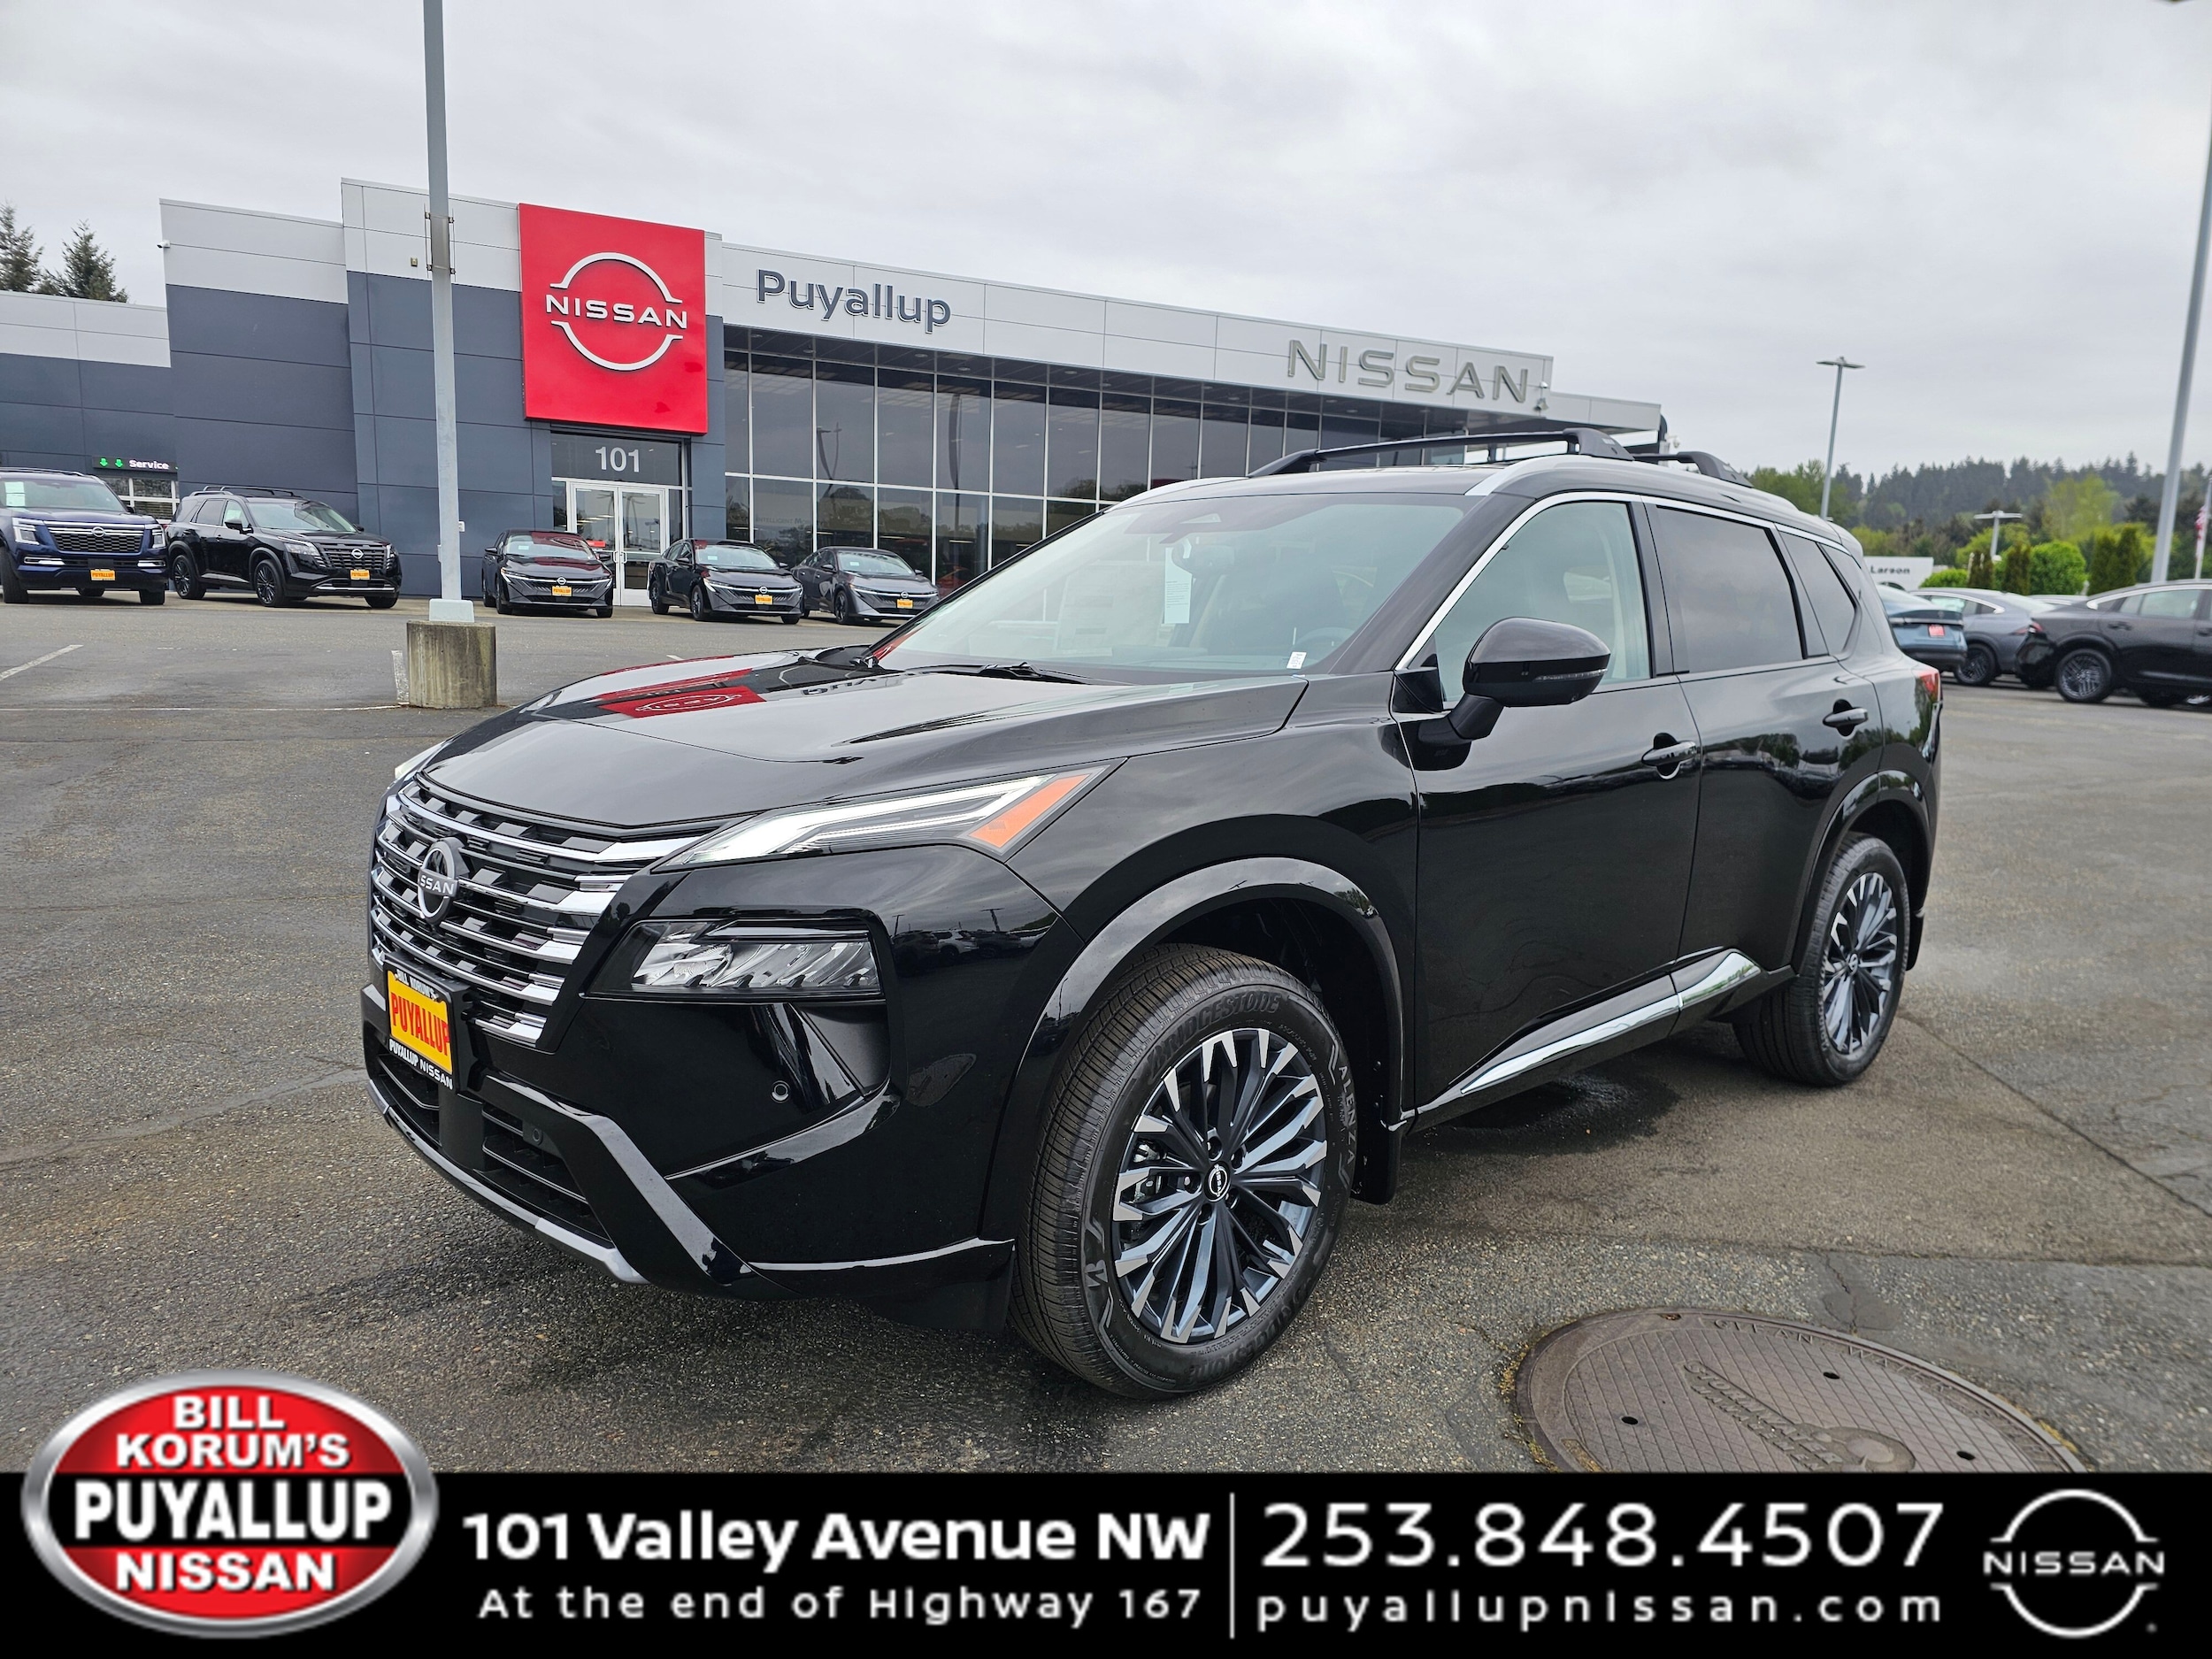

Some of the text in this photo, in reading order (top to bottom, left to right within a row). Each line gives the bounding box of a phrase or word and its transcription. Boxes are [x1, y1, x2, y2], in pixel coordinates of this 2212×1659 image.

[545, 294, 687, 329] NISSAN
[757, 268, 951, 334] Puyallup
[1287, 339, 1529, 403] NISSAN
[128, 459, 170, 470] Service
[595, 446, 640, 472] 101
[1870, 565, 1911, 574] Larson
[420, 874, 455, 895] SSAN
[390, 992, 450, 1056] PUYALLUP
[389, 1039, 453, 1090] PUYALLUP NISSAN
[1338, 1065, 1357, 1164] ALENZA
[1690, 1385, 1826, 1471] MANAGEMEN
